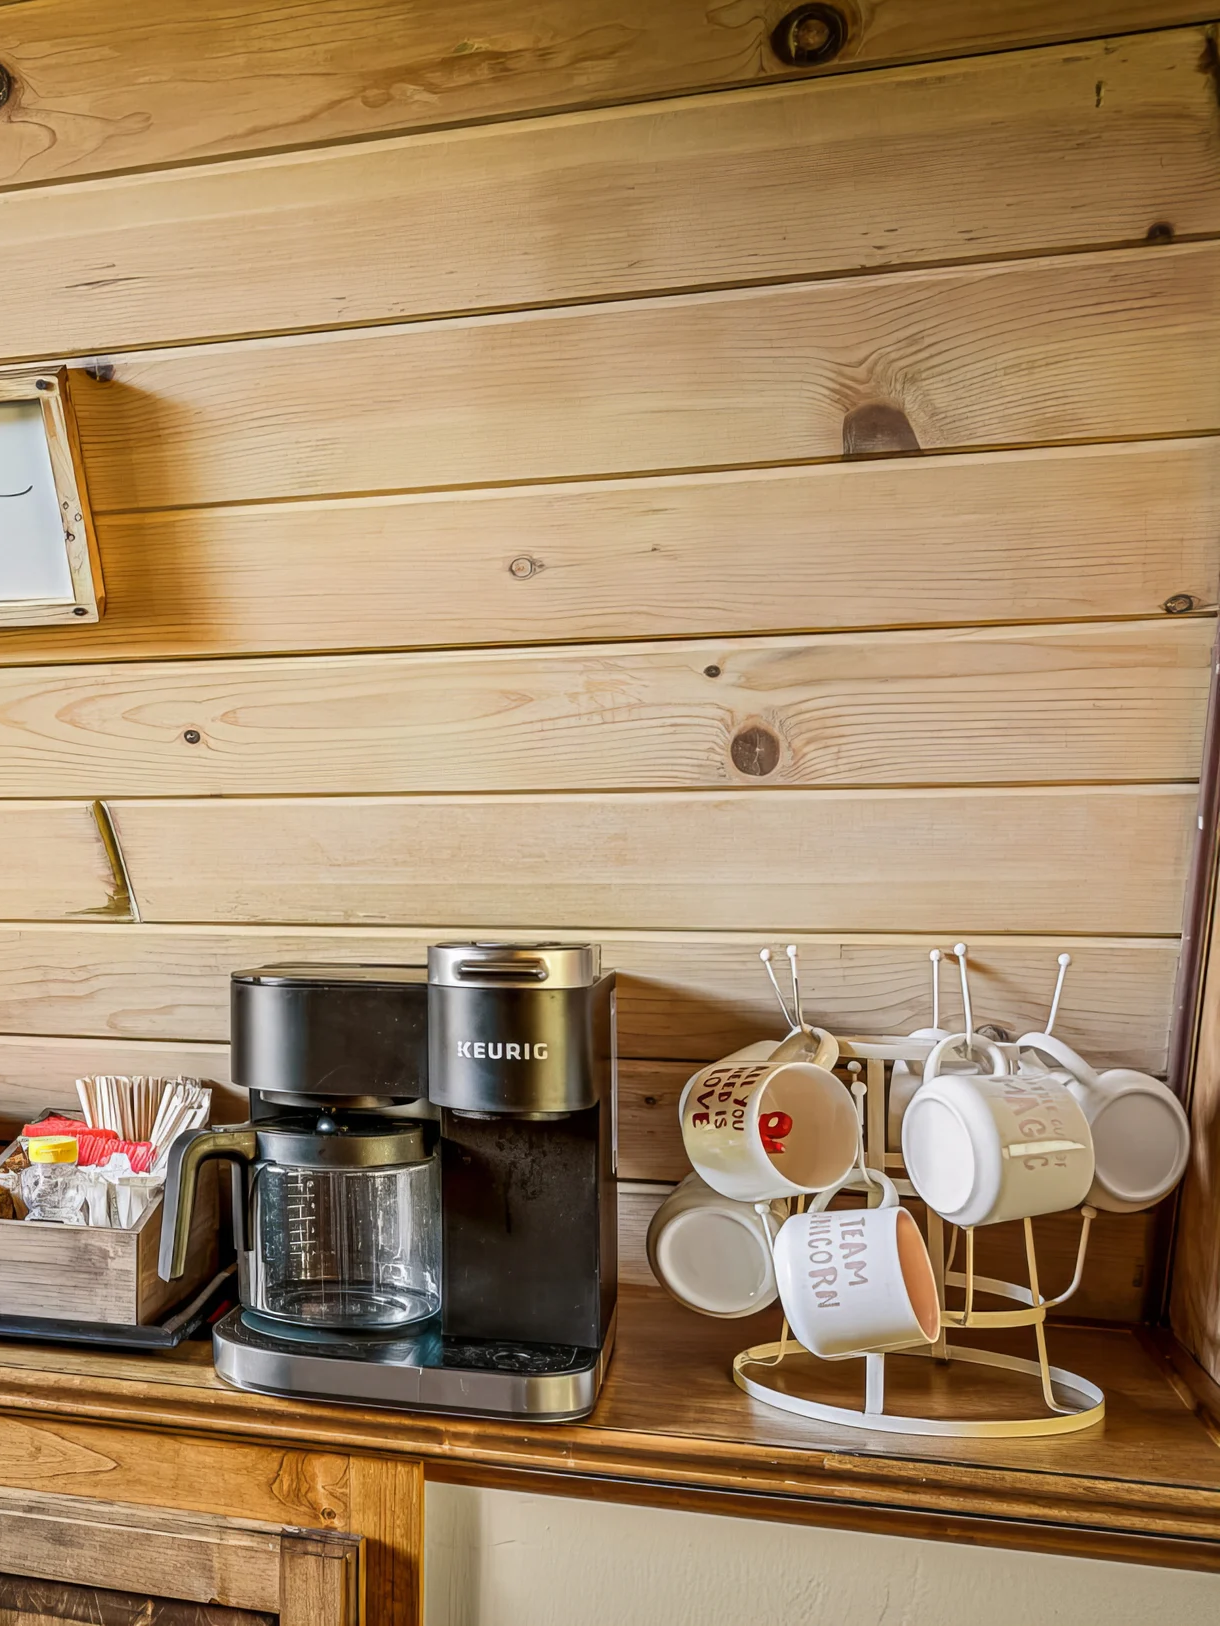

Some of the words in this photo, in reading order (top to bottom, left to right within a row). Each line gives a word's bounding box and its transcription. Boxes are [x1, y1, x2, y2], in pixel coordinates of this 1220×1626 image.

[457, 1041, 548, 1060] KEURIG
[717, 1067, 752, 1103] NEED
[739, 1065, 770, 1088] ALL
[692, 1068, 733, 1129] LOVE
[731, 1095, 749, 1132] YOU
[714, 1110, 727, 1129] IS
[988, 1078, 1050, 1171] MAGC
[839, 1216, 869, 1287] TEAM
